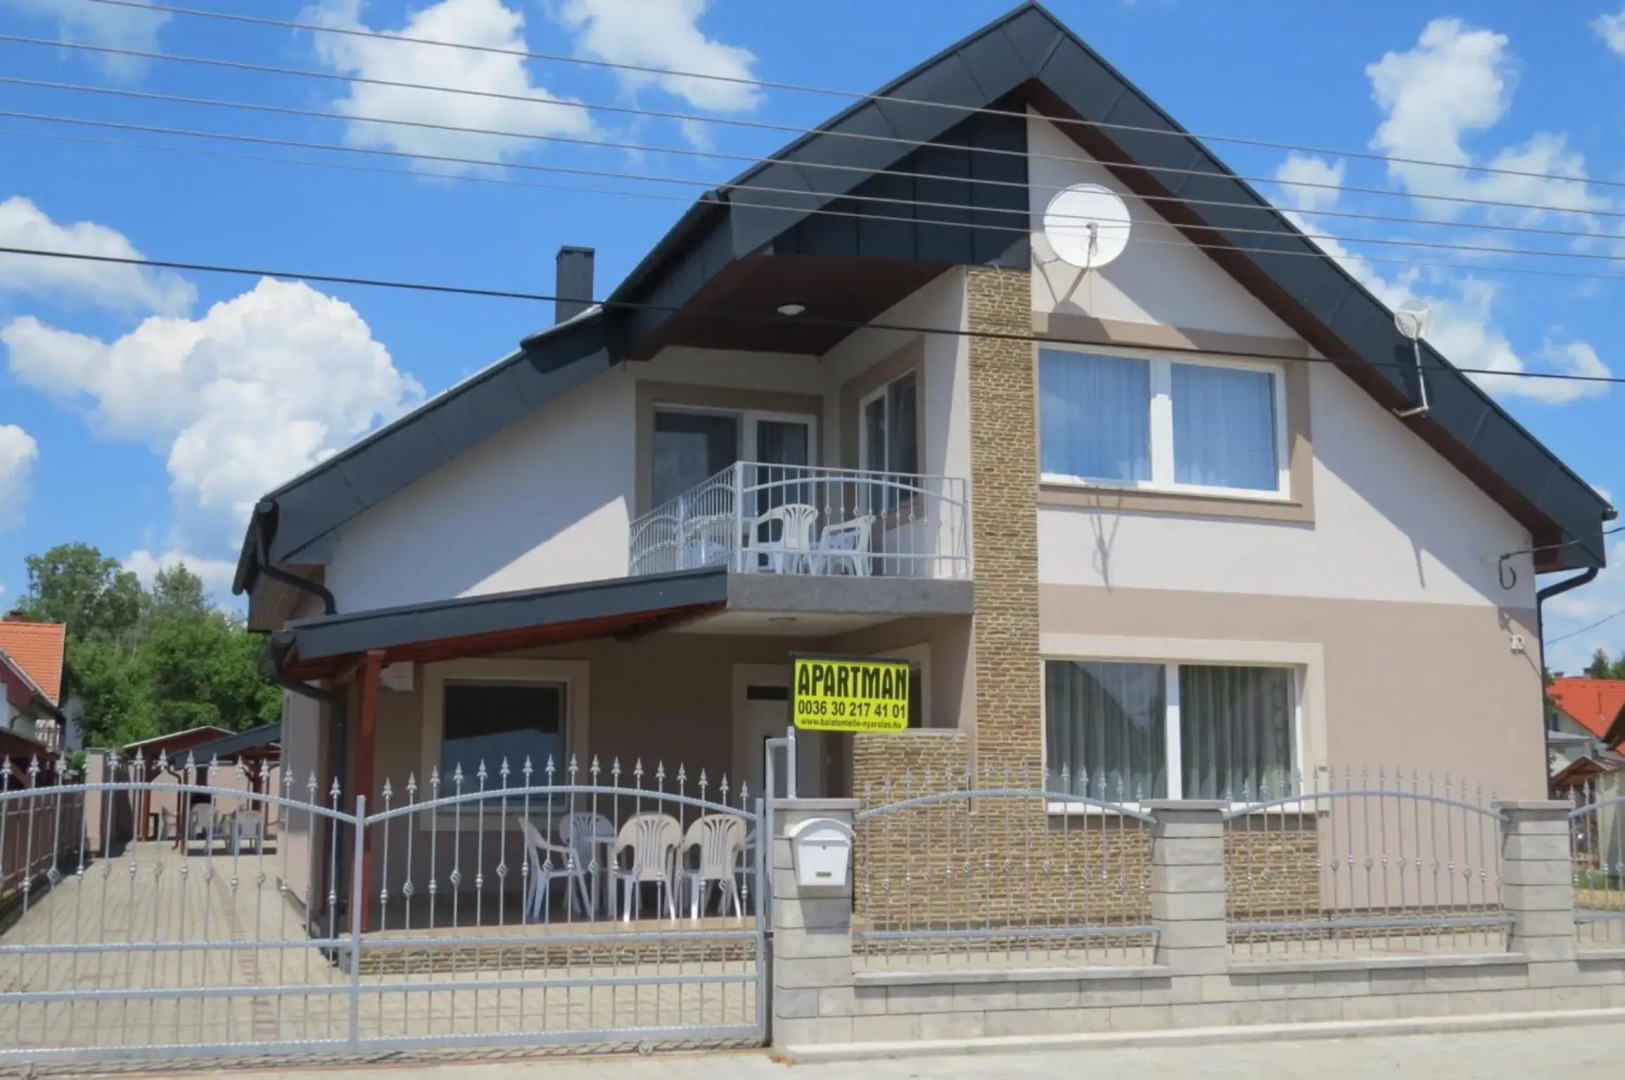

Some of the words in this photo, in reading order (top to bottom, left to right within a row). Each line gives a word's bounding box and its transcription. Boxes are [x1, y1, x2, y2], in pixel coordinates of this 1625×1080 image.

[798, 664, 907, 700] APARTMAN
[798, 700, 827, 715] 0036
[831, 702, 846, 716] 30
[849, 702, 871, 717] 217
[874, 703, 888, 718] 41
[892, 704, 906, 719] 01
